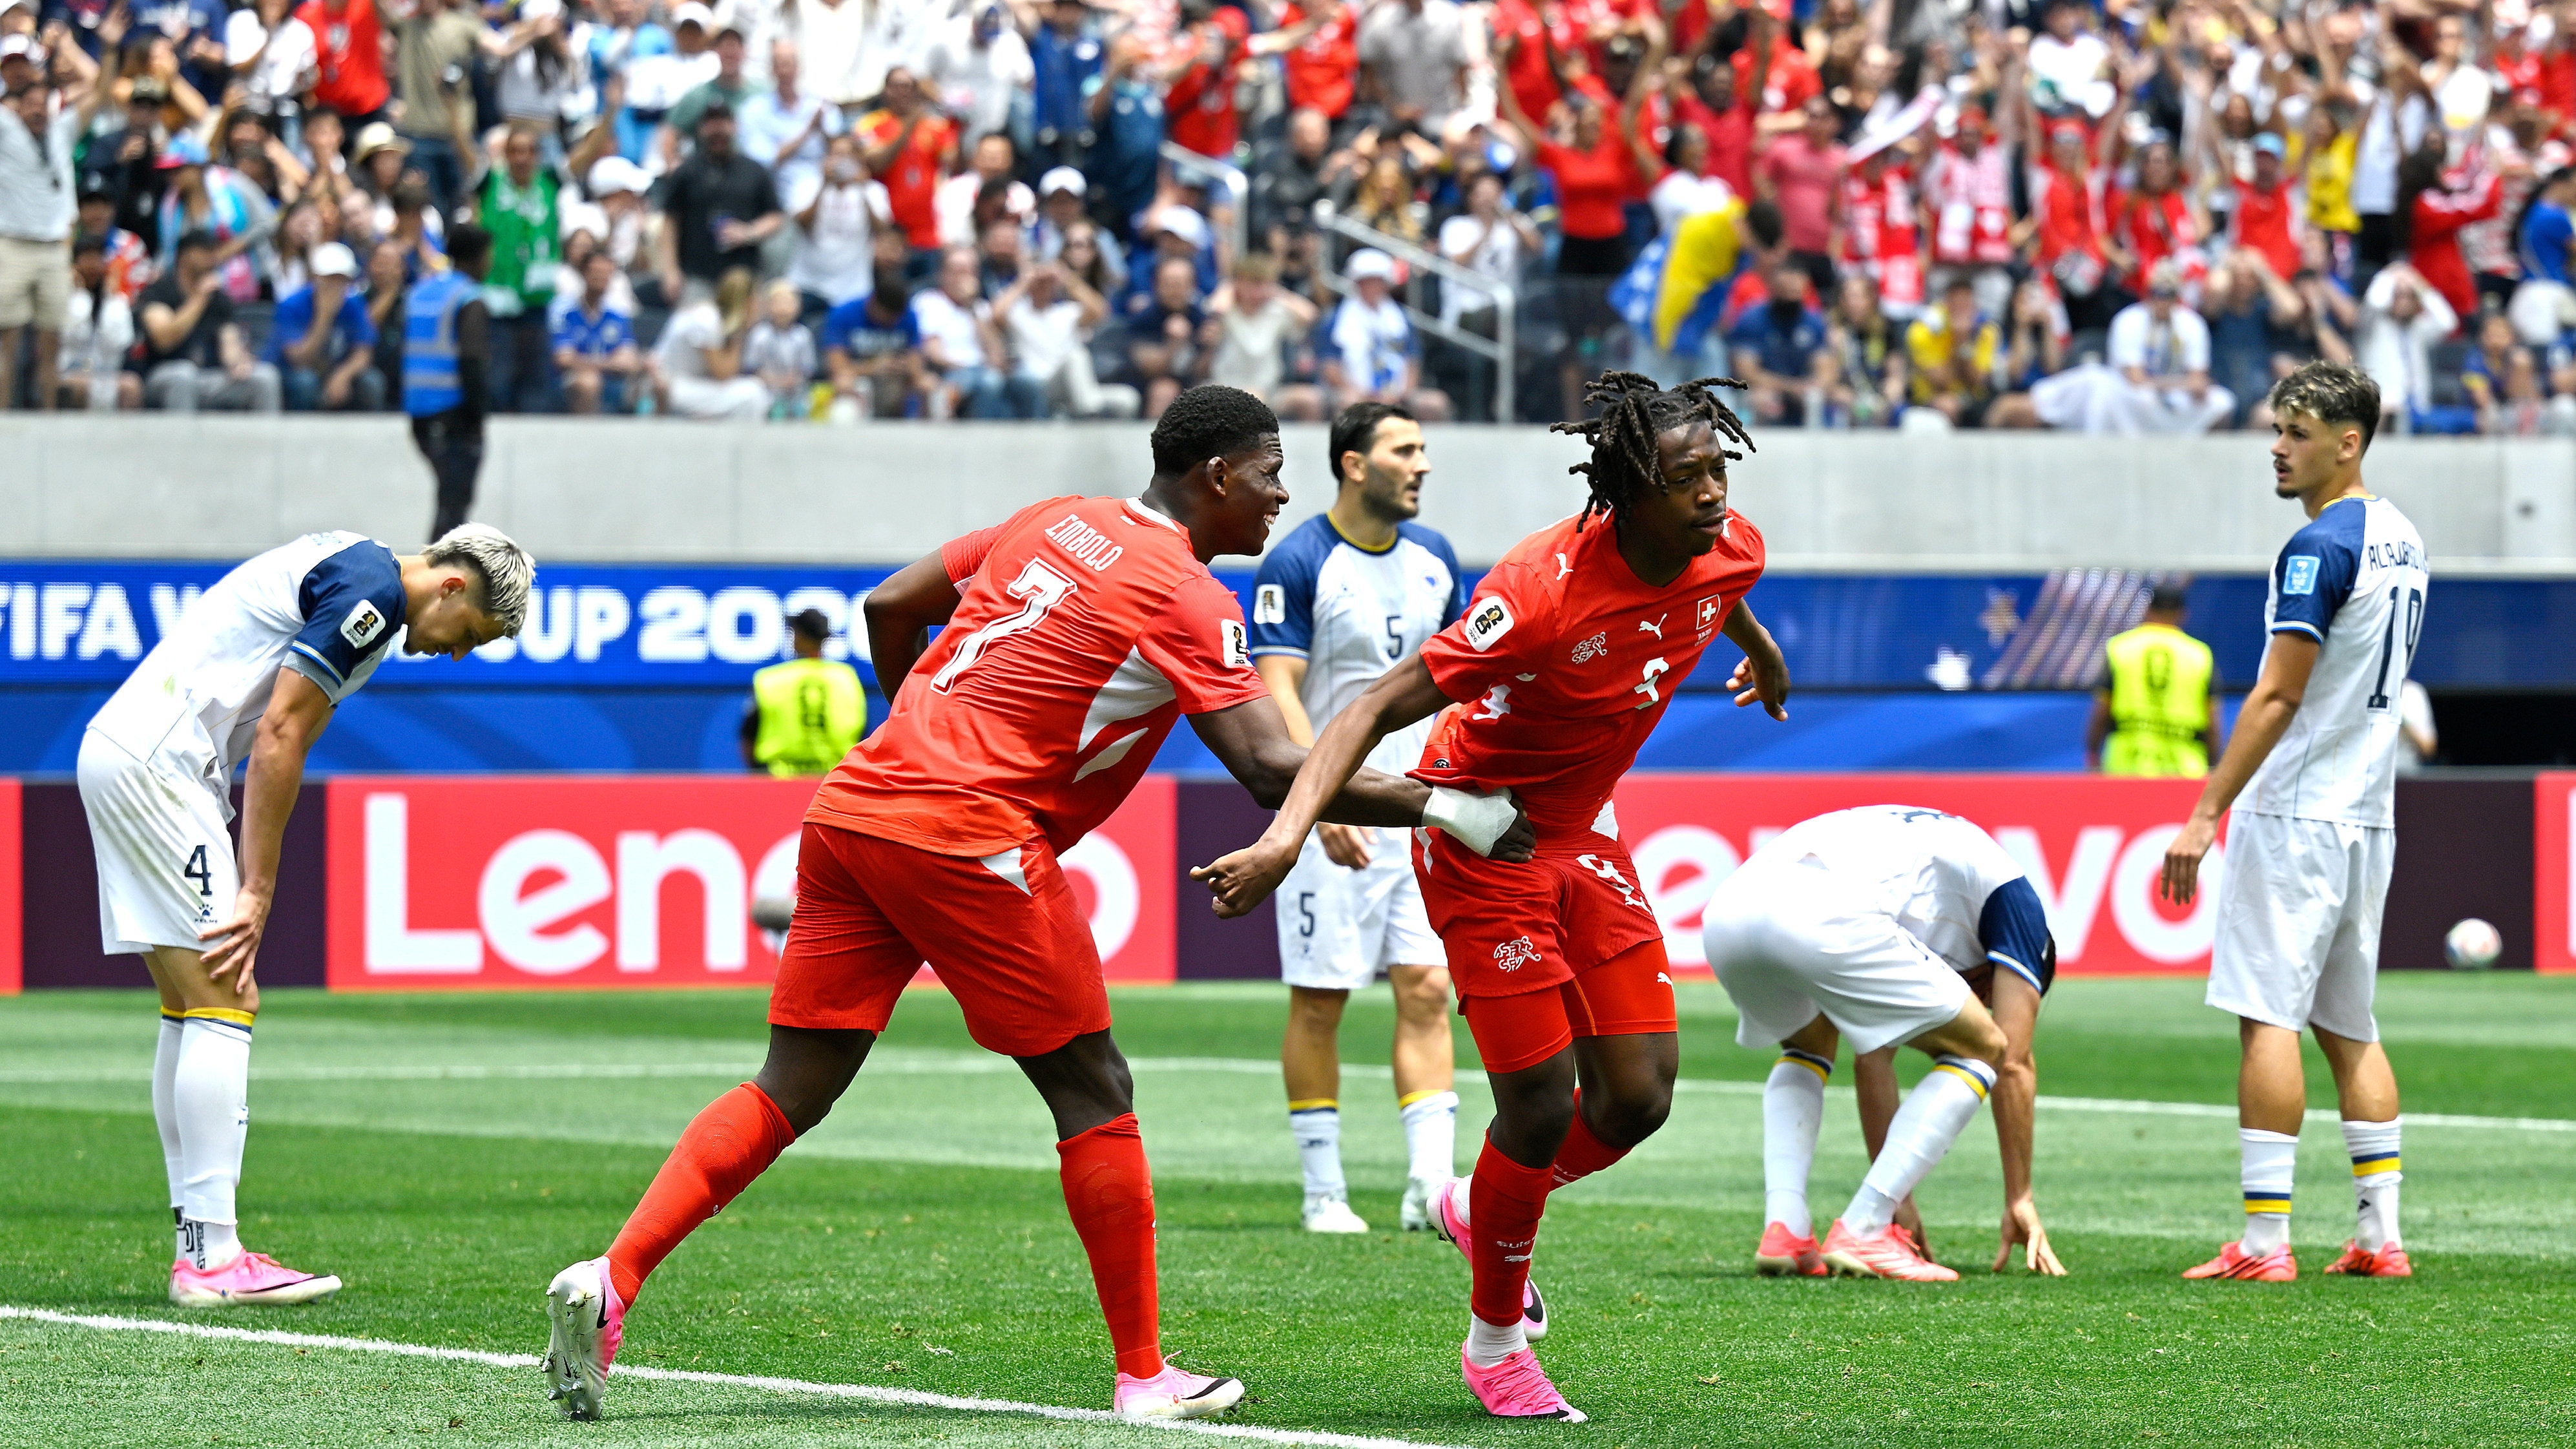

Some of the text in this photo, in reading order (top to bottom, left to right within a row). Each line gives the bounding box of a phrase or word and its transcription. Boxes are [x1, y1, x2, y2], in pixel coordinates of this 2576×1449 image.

[1044, 514, 1124, 572] EMBOLO
[0, 581, 143, 661] IFA
[930, 556, 1078, 696] 7
[1386, 616, 1403, 659] 5
[2367, 585, 2422, 713] 19
[185, 844, 213, 896] 4
[1300, 893, 1314, 937] 5
